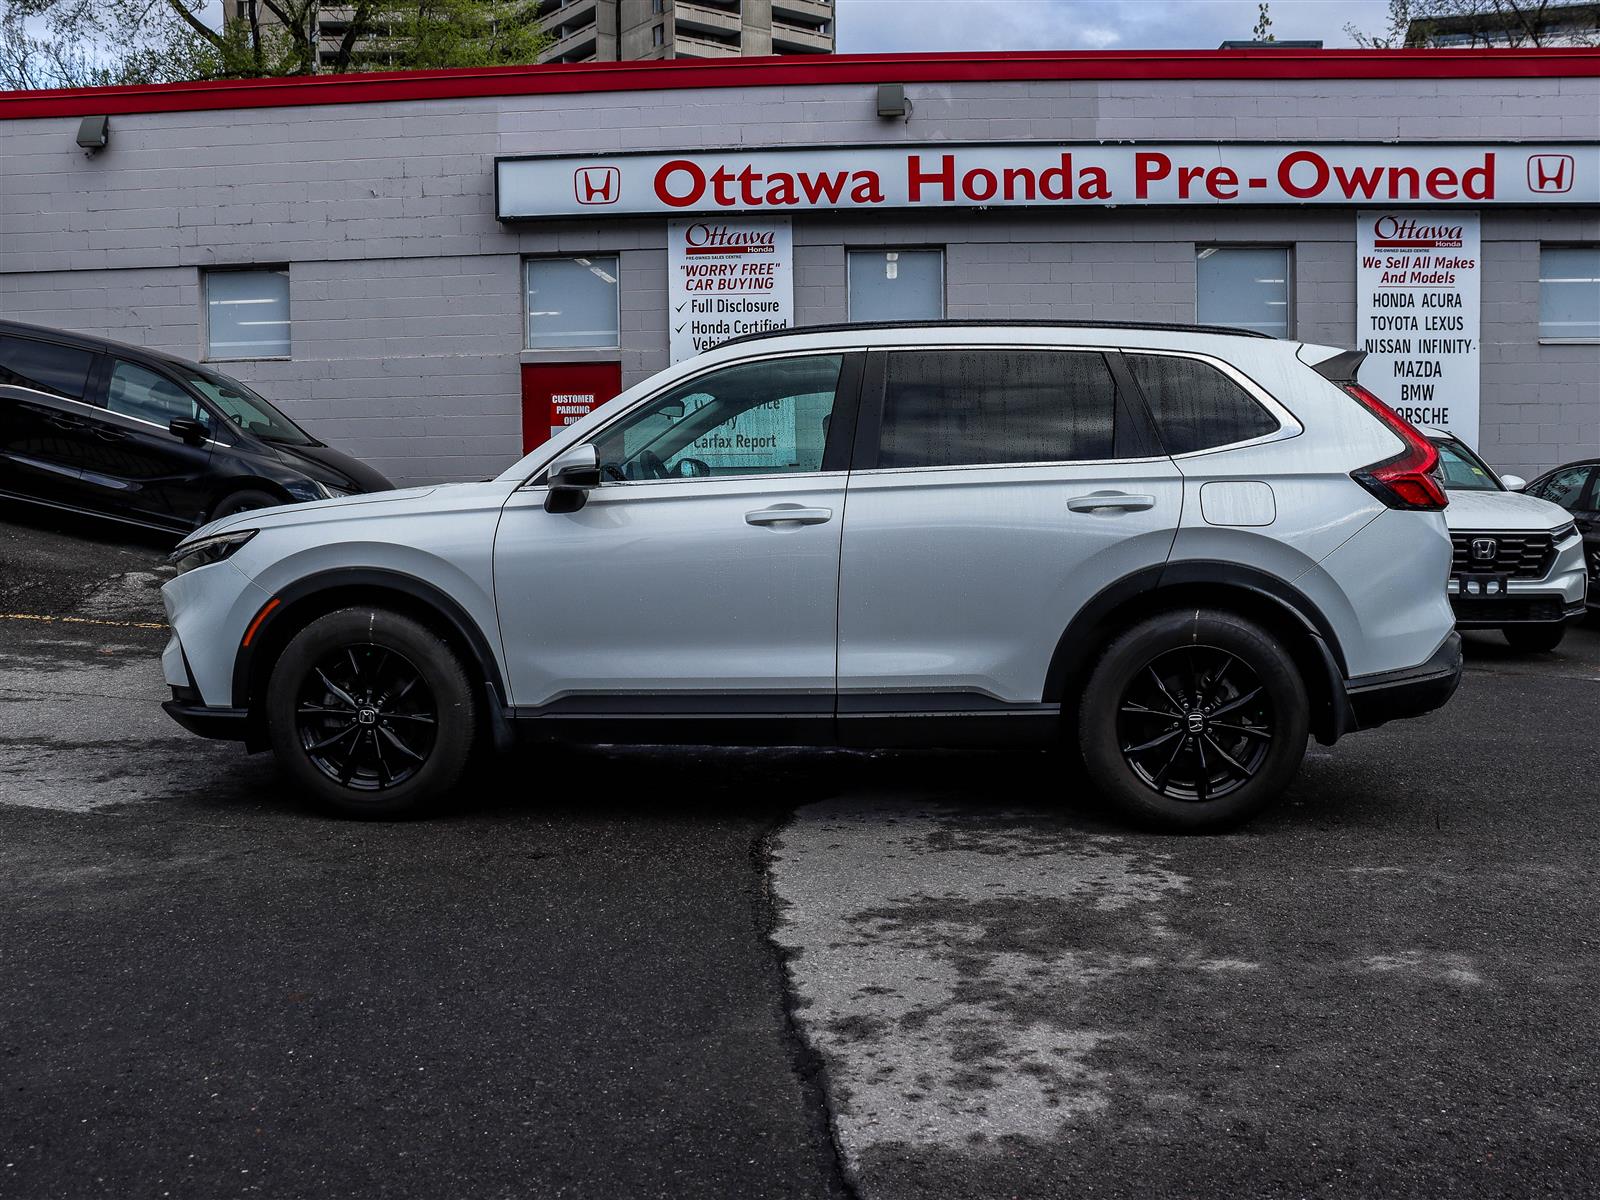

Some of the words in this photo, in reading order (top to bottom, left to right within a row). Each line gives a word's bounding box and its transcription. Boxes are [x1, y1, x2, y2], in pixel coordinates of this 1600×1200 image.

[653, 159, 885, 208] Ottawa
[907, 152, 1113, 202] Honda
[1134, 150, 1497, 200] Pre-Owned
[685, 222, 776, 247] Ottawa
[1374, 214, 1464, 240] Ottawa
[680, 263, 738, 277] "WORRY
[741, 262, 781, 275] FREE"
[1362, 256, 1382, 269] We
[1385, 256, 1410, 269] Sell
[1412, 256, 1432, 269] All
[1434, 256, 1475, 269] Makes
[685, 278, 714, 292] CAR
[717, 277, 774, 291] BUYING
[1380, 271, 1407, 283] And
[1409, 270, 1456, 284] Models
[691, 298, 713, 313] Full
[717, 298, 780, 312] Disclosure
[1373, 293, 1415, 308] HONDA
[1421, 293, 1463, 308] ACURA
[691, 319, 730, 335] Honda
[733, 319, 787, 334] Certified
[1370, 316, 1419, 331] TOYOTA
[1425, 316, 1464, 331] LEXUS
[1365, 339, 1411, 354] NISSAN
[1418, 339, 1472, 354] INFINITY
[1393, 360, 1443, 378] MAZDA
[551, 394, 595, 404] CUSTOMER
[1401, 384, 1435, 401] BMW
[556, 405, 590, 415] PARKING
[1394, 407, 1449, 424] ORSCHE
[693, 434, 733, 449] Carfax
[736, 434, 777, 452] Report
